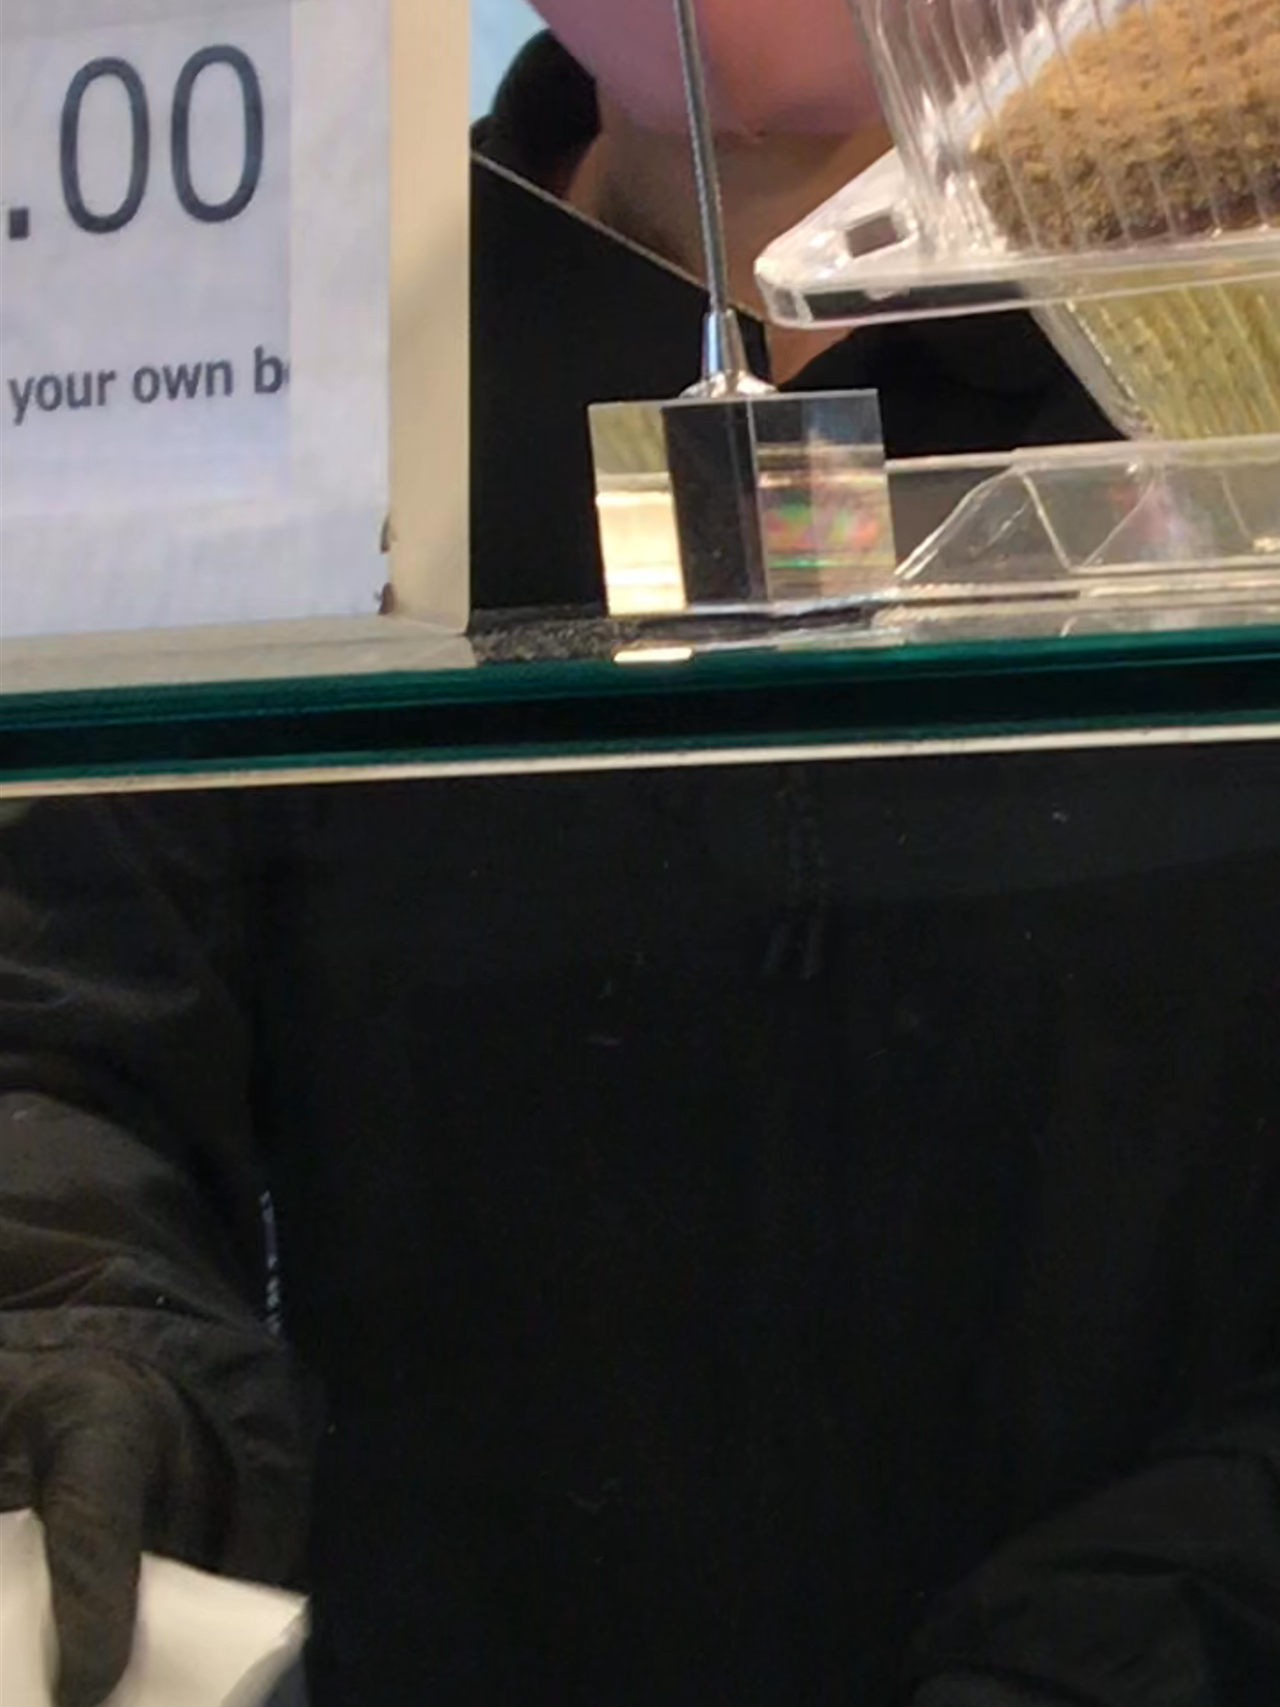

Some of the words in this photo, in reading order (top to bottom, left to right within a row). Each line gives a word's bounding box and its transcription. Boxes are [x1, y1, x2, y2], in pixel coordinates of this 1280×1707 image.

[7, 369, 116, 424] your
[132, 360, 234, 404] own
[254, 344, 290, 395] b
